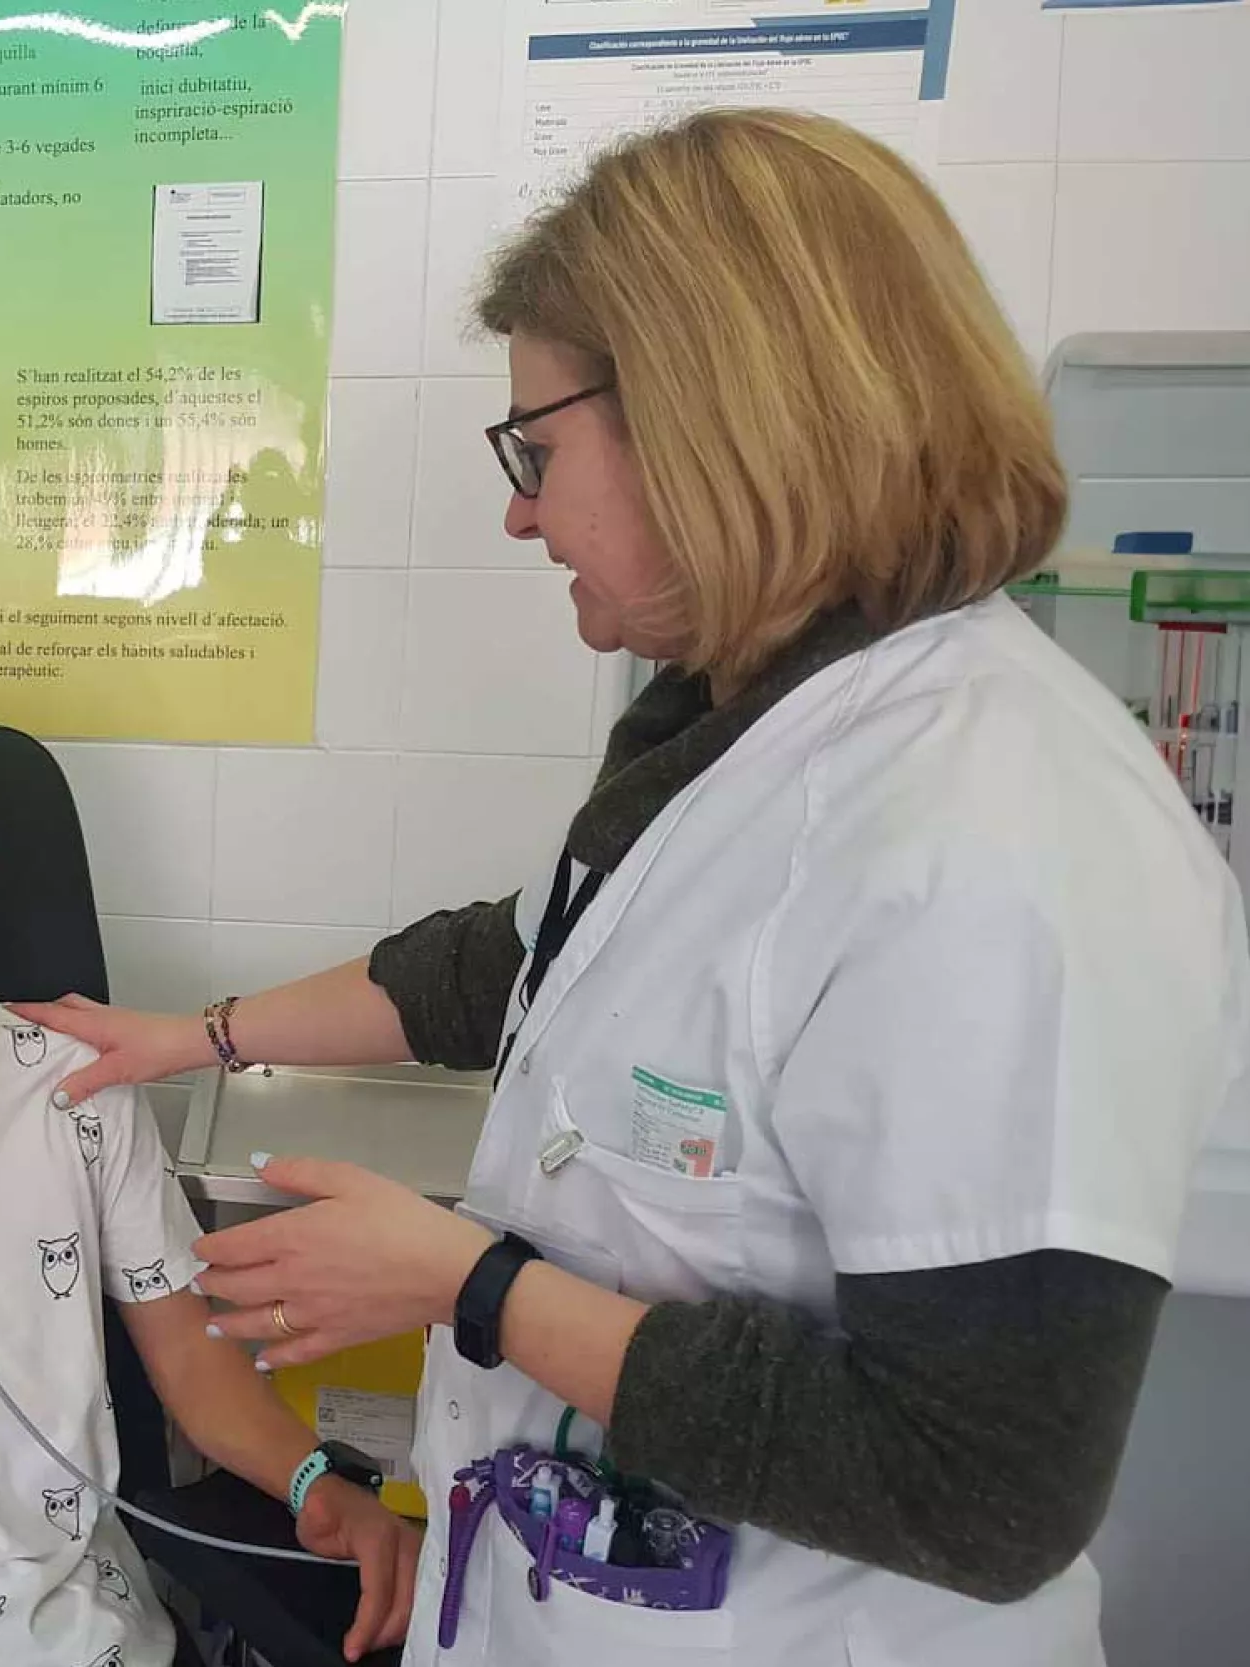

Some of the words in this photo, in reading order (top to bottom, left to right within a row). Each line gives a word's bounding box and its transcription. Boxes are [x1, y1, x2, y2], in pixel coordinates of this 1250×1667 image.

[254, 13, 267, 29] la
[93, 77, 103, 92] 6
[140, 79, 174, 96] inici
[178, 76, 252, 95] dubitatiu,
[134, 126, 234, 147] incompleta...
[6, 139, 30, 154] 3-6
[36, 137, 95, 157] vegades
[62, 192, 82, 205] no
[65, 367, 122, 383] realitzat
[127, 367, 140, 381] el
[198, 366, 215, 381] de
[221, 366, 242, 381] les
[16, 391, 68, 409] espiros
[73, 390, 160, 409] proposades,
[247, 388, 261, 404] el
[16, 414, 63, 429] 51,2%
[69, 413, 93, 428] són
[98, 412, 140, 428] dones
[154, 416, 173, 428] un
[230, 412, 257, 427] són
[16, 469, 38, 484] De
[43, 468, 62, 484] les
[16, 491, 66, 506] trobem
[270, 517, 289, 528] un
[8, 609, 22, 623] el
[26, 610, 98, 628] seguiment
[103, 613, 152, 629] segons
[156, 610, 198, 627] nivell
[16, 640, 33, 656] de
[37, 641, 93, 659] reforçar
[96, 643, 118, 657] els
[169, 644, 245, 659] saludables
